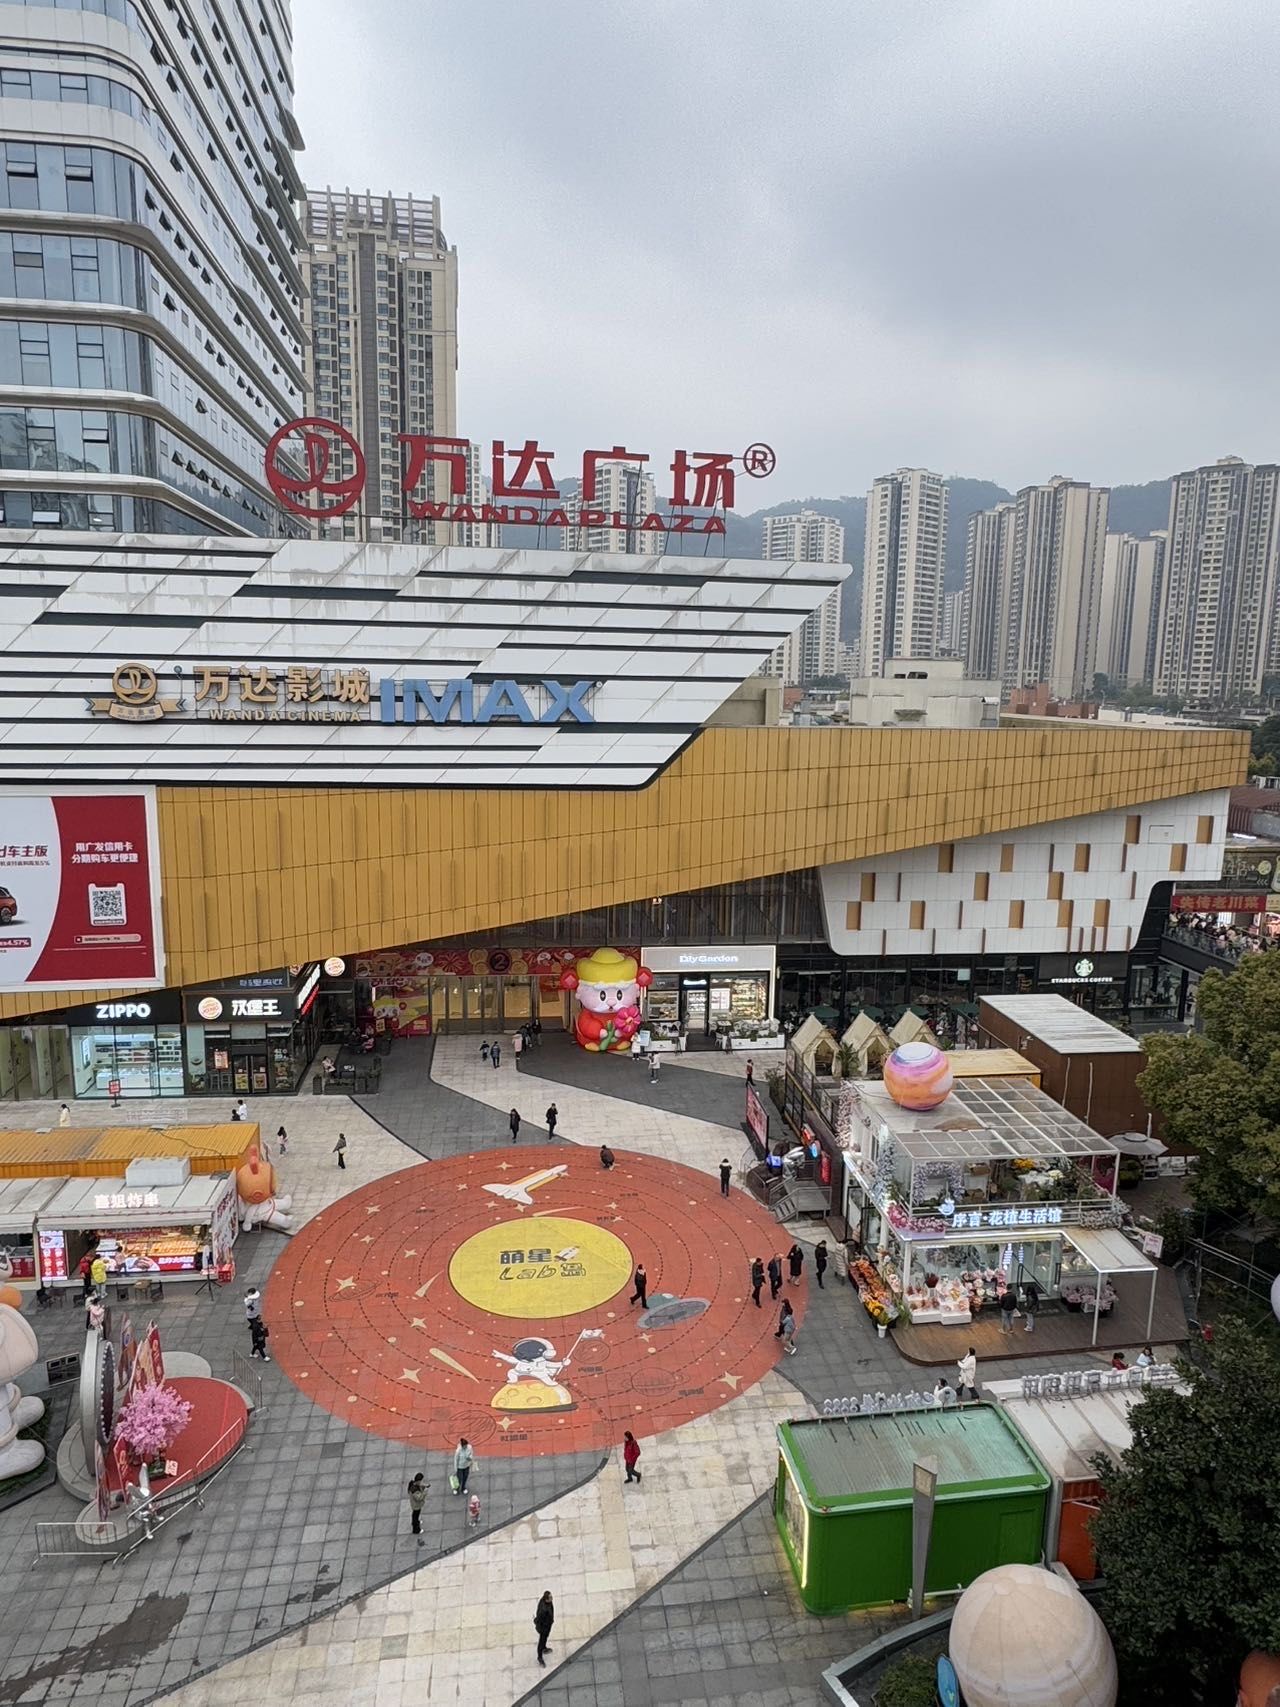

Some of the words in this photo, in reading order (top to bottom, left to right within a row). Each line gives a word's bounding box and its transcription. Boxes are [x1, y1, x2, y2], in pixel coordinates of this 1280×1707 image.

[397, 434, 735, 508] 万达广场
[409, 501, 570, 526] WANDA
[580, 509, 727, 534] PLAZA
[192, 665, 371, 705] 万达影城
[379, 678, 598, 724] IMAX
[208, 709, 280, 721] WANDA
[288, 710, 362, 722] CINEMA
[494, 953, 506, 970] 2
[96, 1003, 151, 1019] ZIPPO
[231, 999, 282, 1016] 汉堡王
[500, 1248, 552, 1264] 萌星
